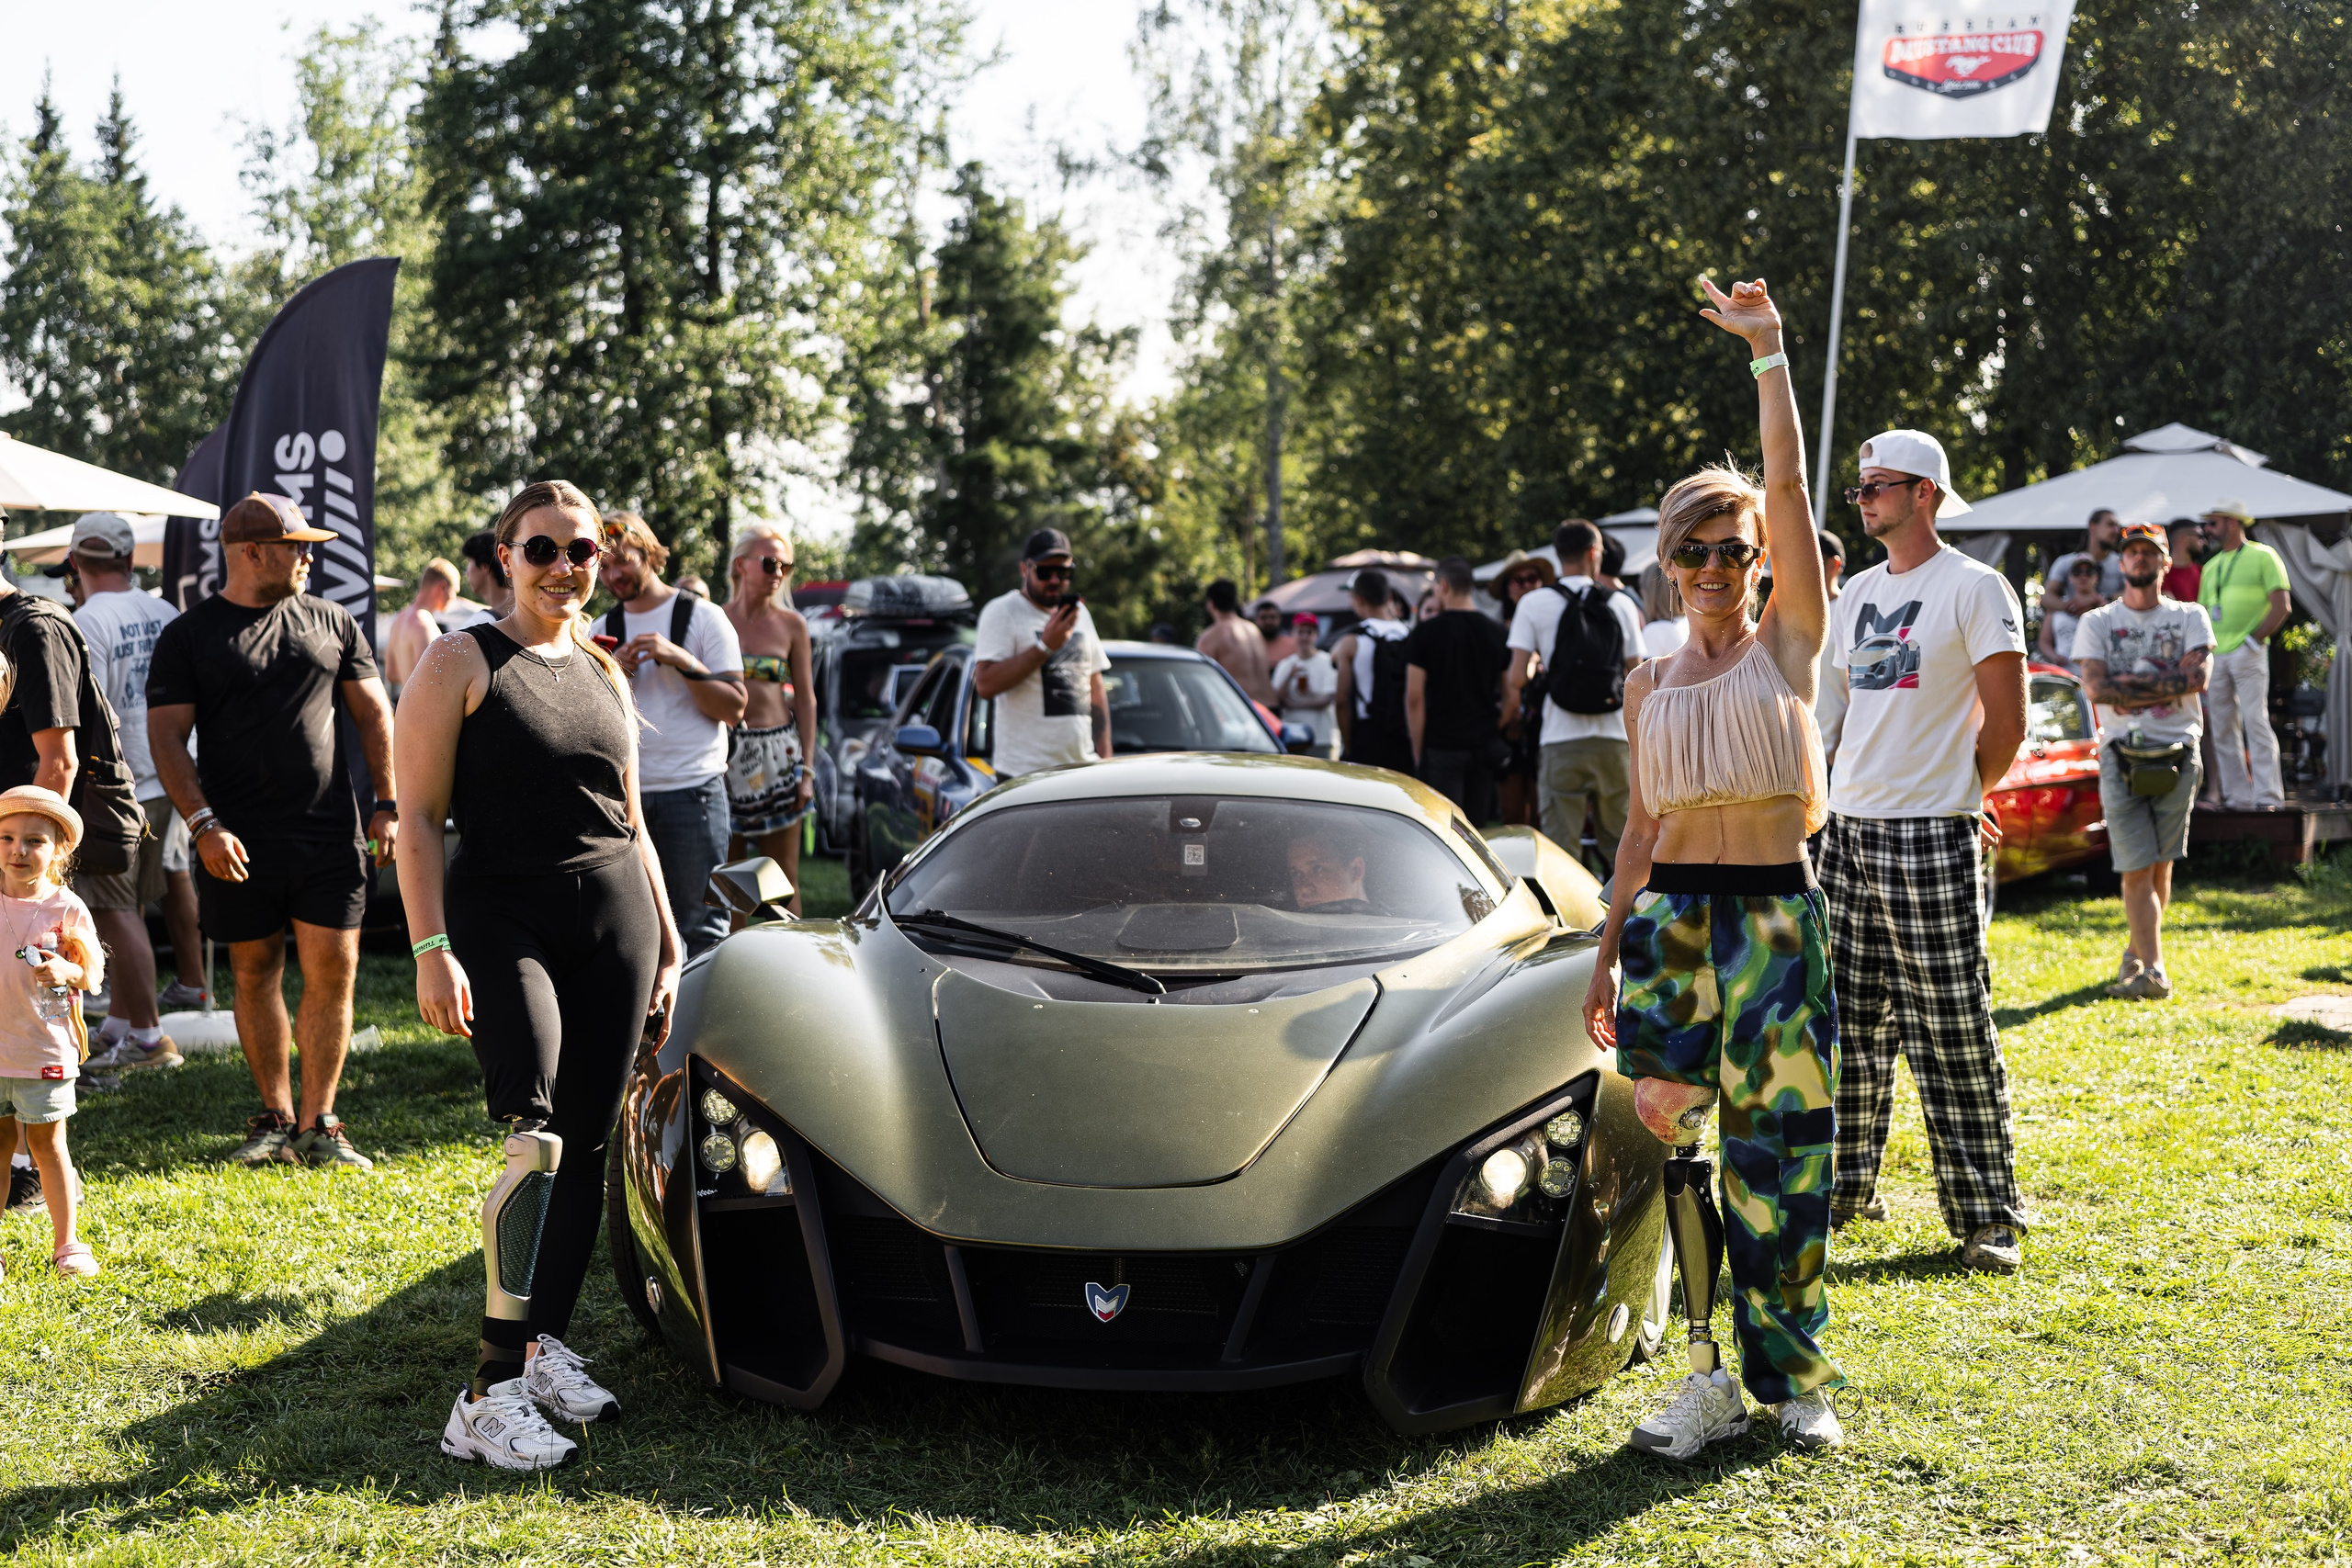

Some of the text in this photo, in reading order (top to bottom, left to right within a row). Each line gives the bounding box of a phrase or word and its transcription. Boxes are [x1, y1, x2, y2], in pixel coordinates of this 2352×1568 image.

[1890, 32, 2038, 62] MUSTANG CLUB
[119, 623, 141, 640] NOT
[112, 641, 135, 661] JUST
[534, 1371, 554, 1393] N
[481, 1416, 507, 1438] N
